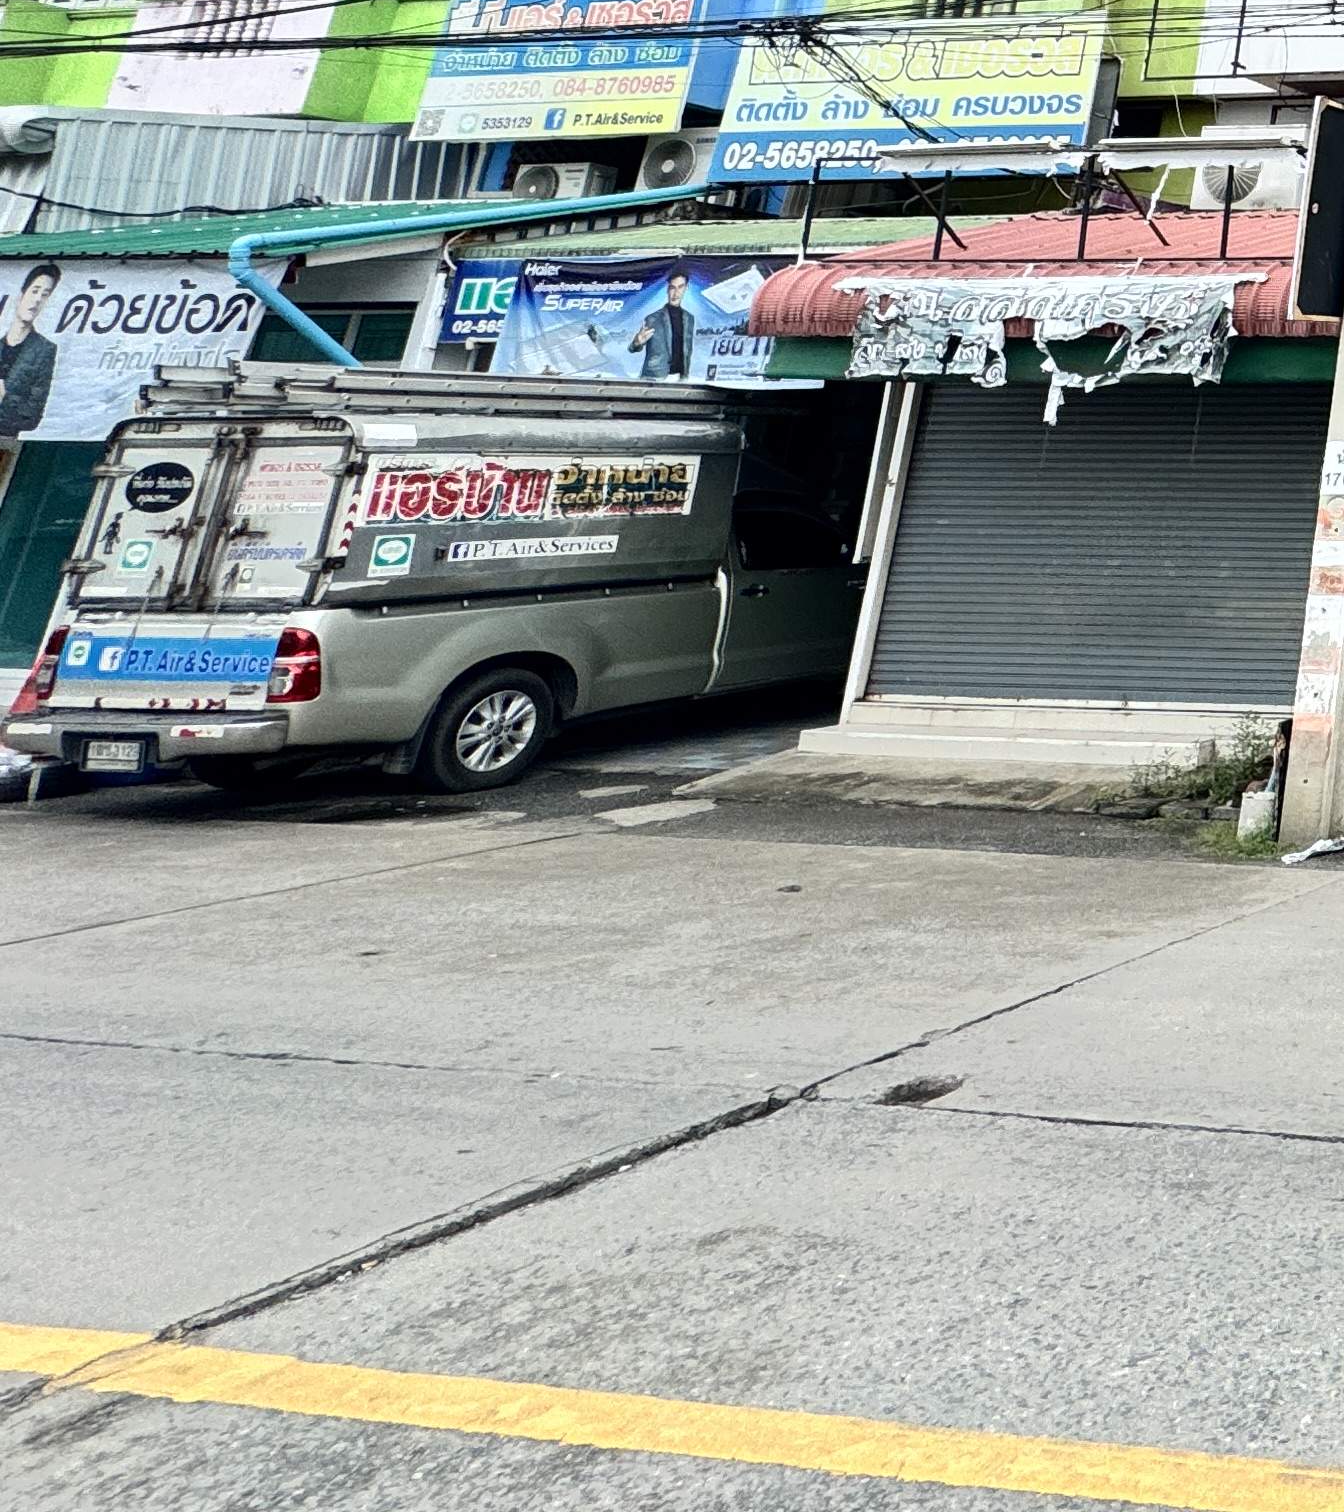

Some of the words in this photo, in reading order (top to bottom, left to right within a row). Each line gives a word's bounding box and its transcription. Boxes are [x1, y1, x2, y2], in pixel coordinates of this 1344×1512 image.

[553, 75, 676, 96] 084-8760985
[736, 91, 807, 122] ติดตั้ง
[821, 94, 869, 120] ล้าง
[952, 92, 1082, 116] ครบวงจร
[482, 117, 532, 130] 5353129
[525, 262, 562, 276] Haier
